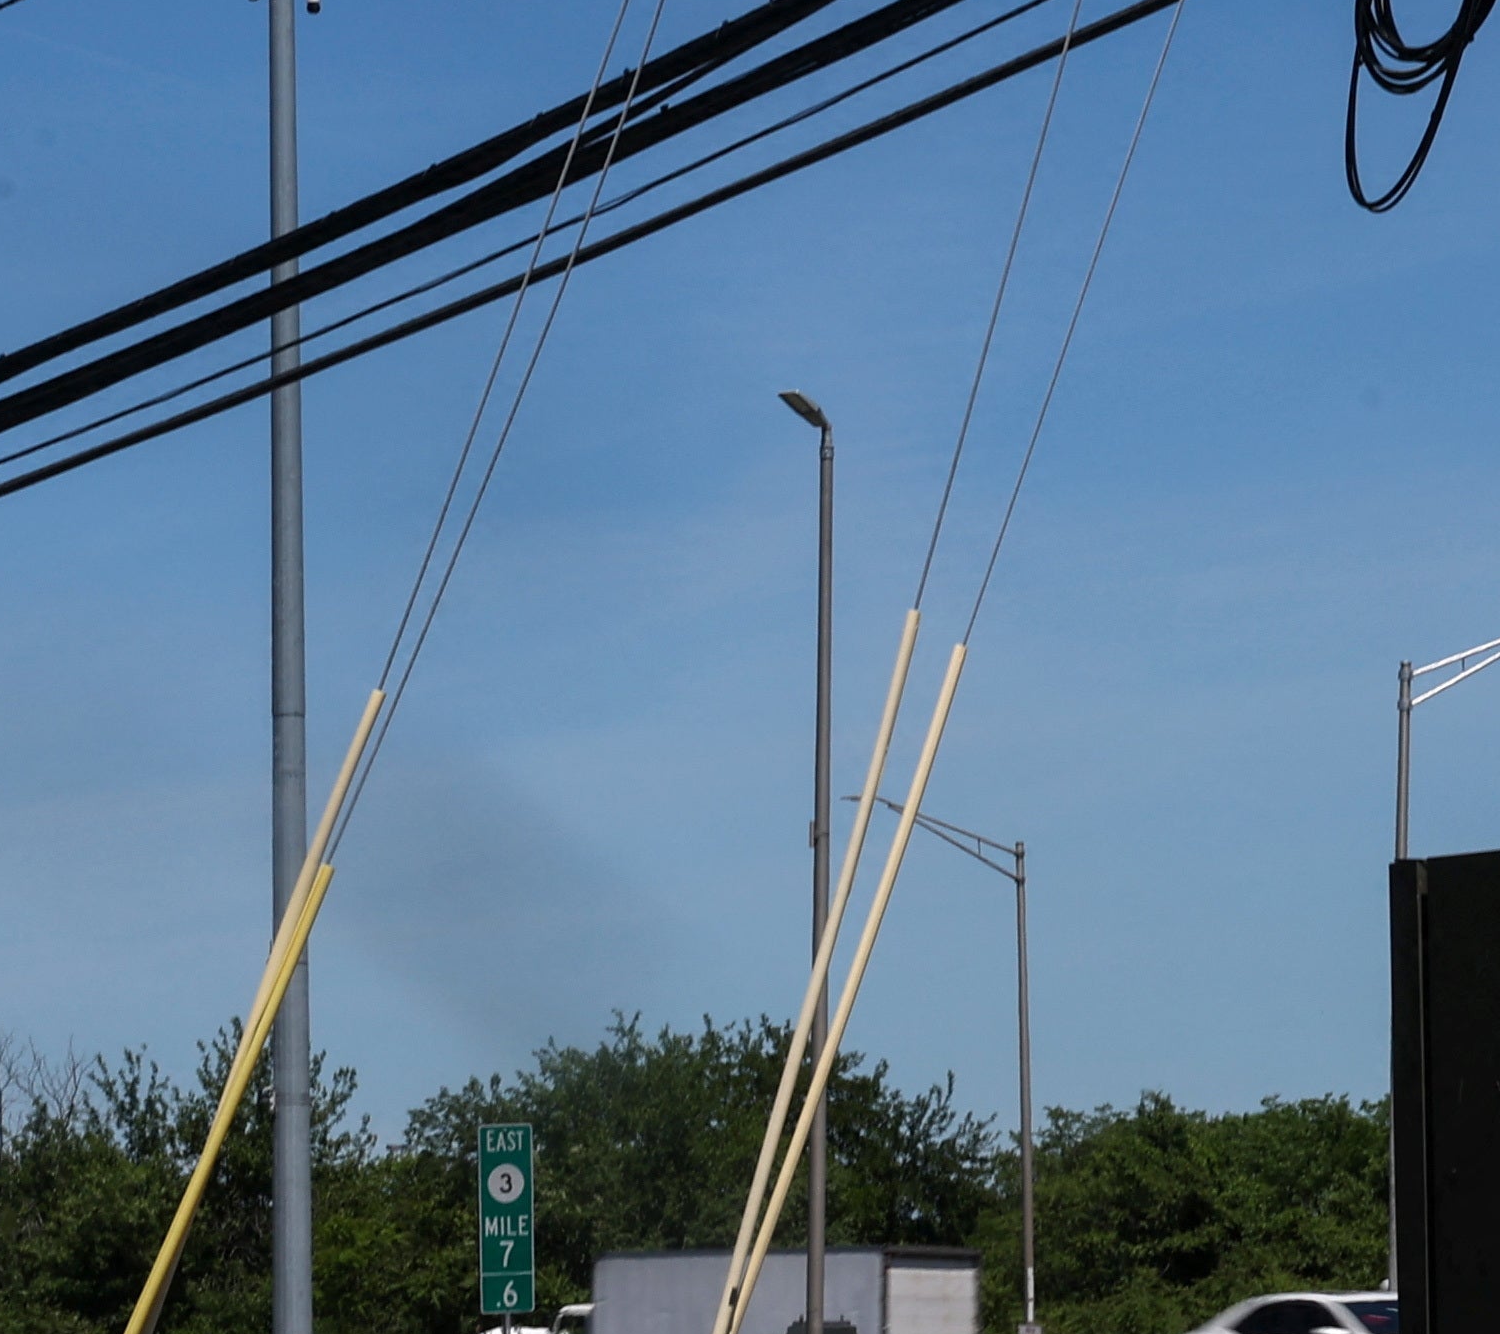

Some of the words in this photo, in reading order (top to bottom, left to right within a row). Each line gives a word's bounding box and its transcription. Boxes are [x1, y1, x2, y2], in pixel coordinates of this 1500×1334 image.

[486, 1130, 524, 1152] EAST
[499, 1173, 512, 1193] 3
[484, 1215, 529, 1237] MILE
[499, 1240, 514, 1267] 7
[496, 1280, 518, 1307] .6
